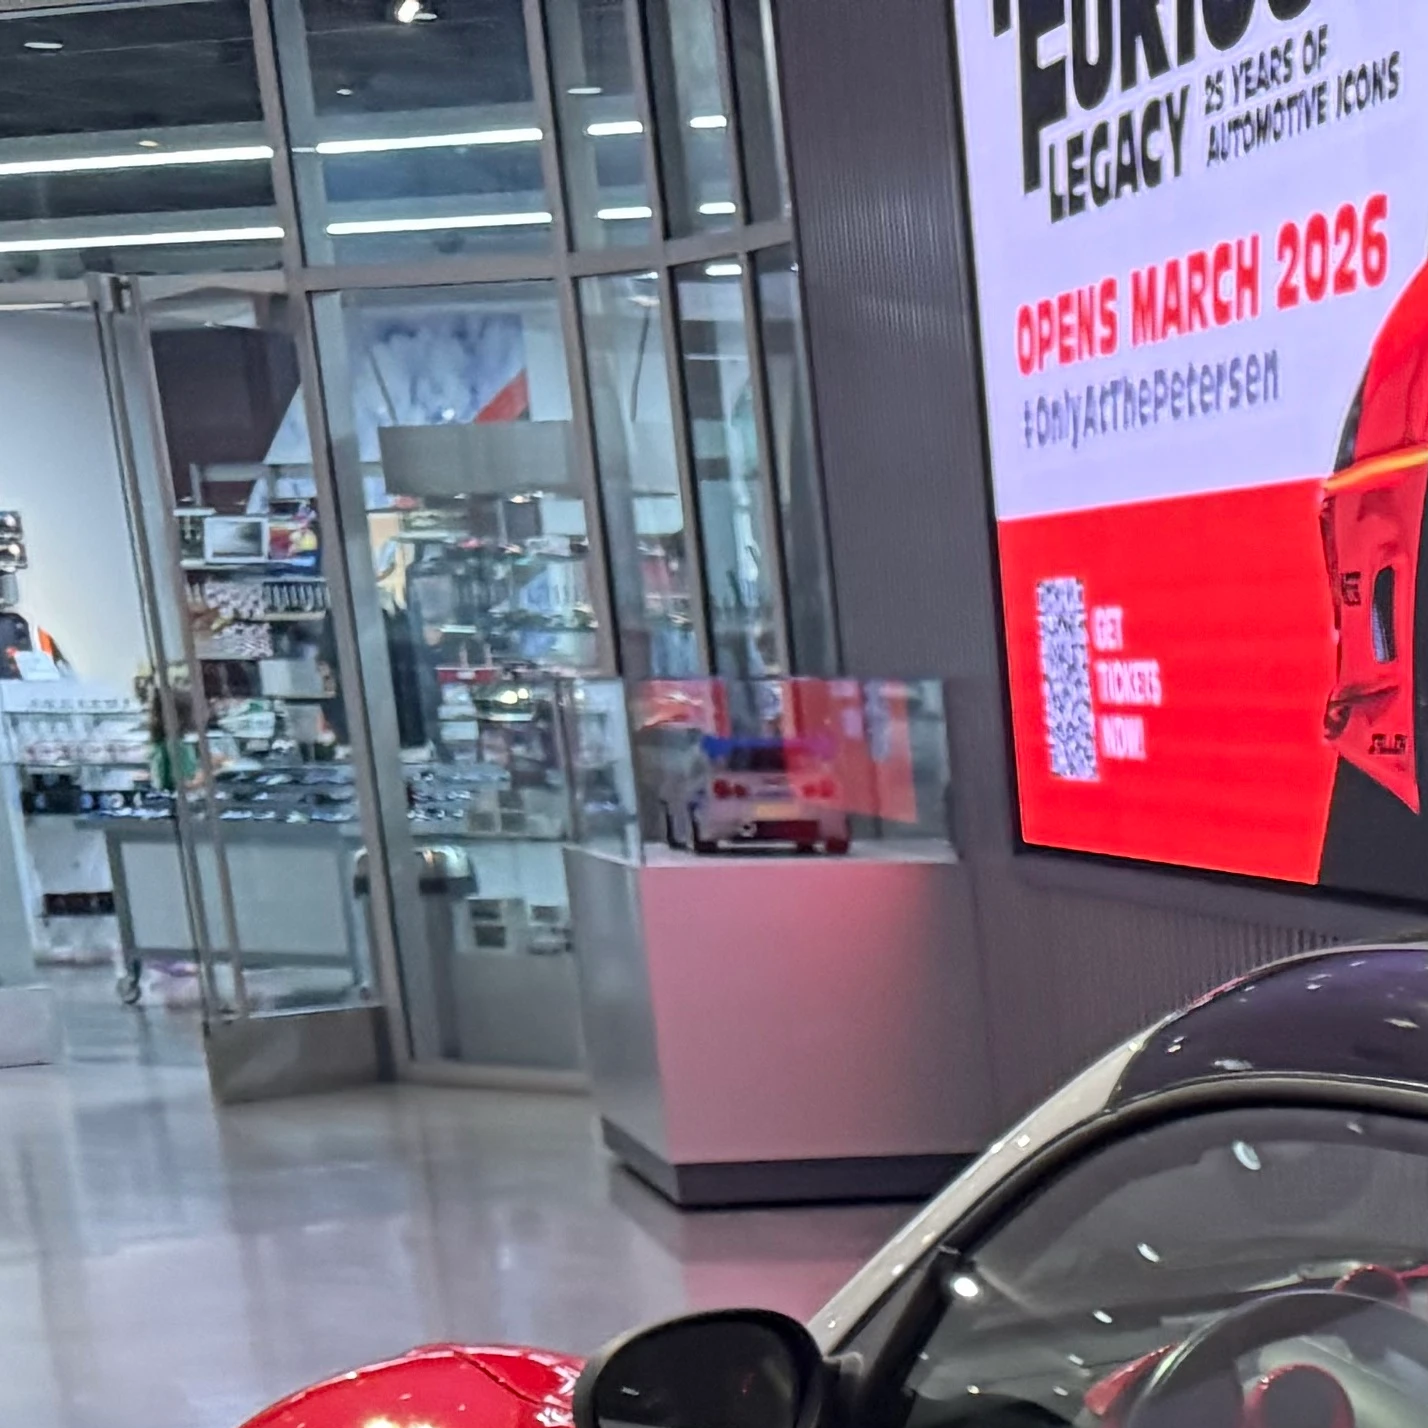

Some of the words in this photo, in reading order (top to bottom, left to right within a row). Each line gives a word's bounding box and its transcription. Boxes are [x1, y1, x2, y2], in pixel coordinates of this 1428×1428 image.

[1203, 67, 1225, 116] 25
[1230, 37, 1294, 106] YEARS
[1301, 23, 1330, 76] OF
[1206, 81, 1328, 168] AUTOMOTIVE
[1334, 50, 1400, 120] ICONS
[1048, 84, 1190, 224] LEGACY
[1015, 278, 1117, 375] OPENS
[1130, 236, 1259, 347] MARCH
[1276, 194, 1389, 308] 2026
[1023, 350, 1279, 450] #OnlyAtThePetersen
[1095, 660, 1162, 706] TICKETS
